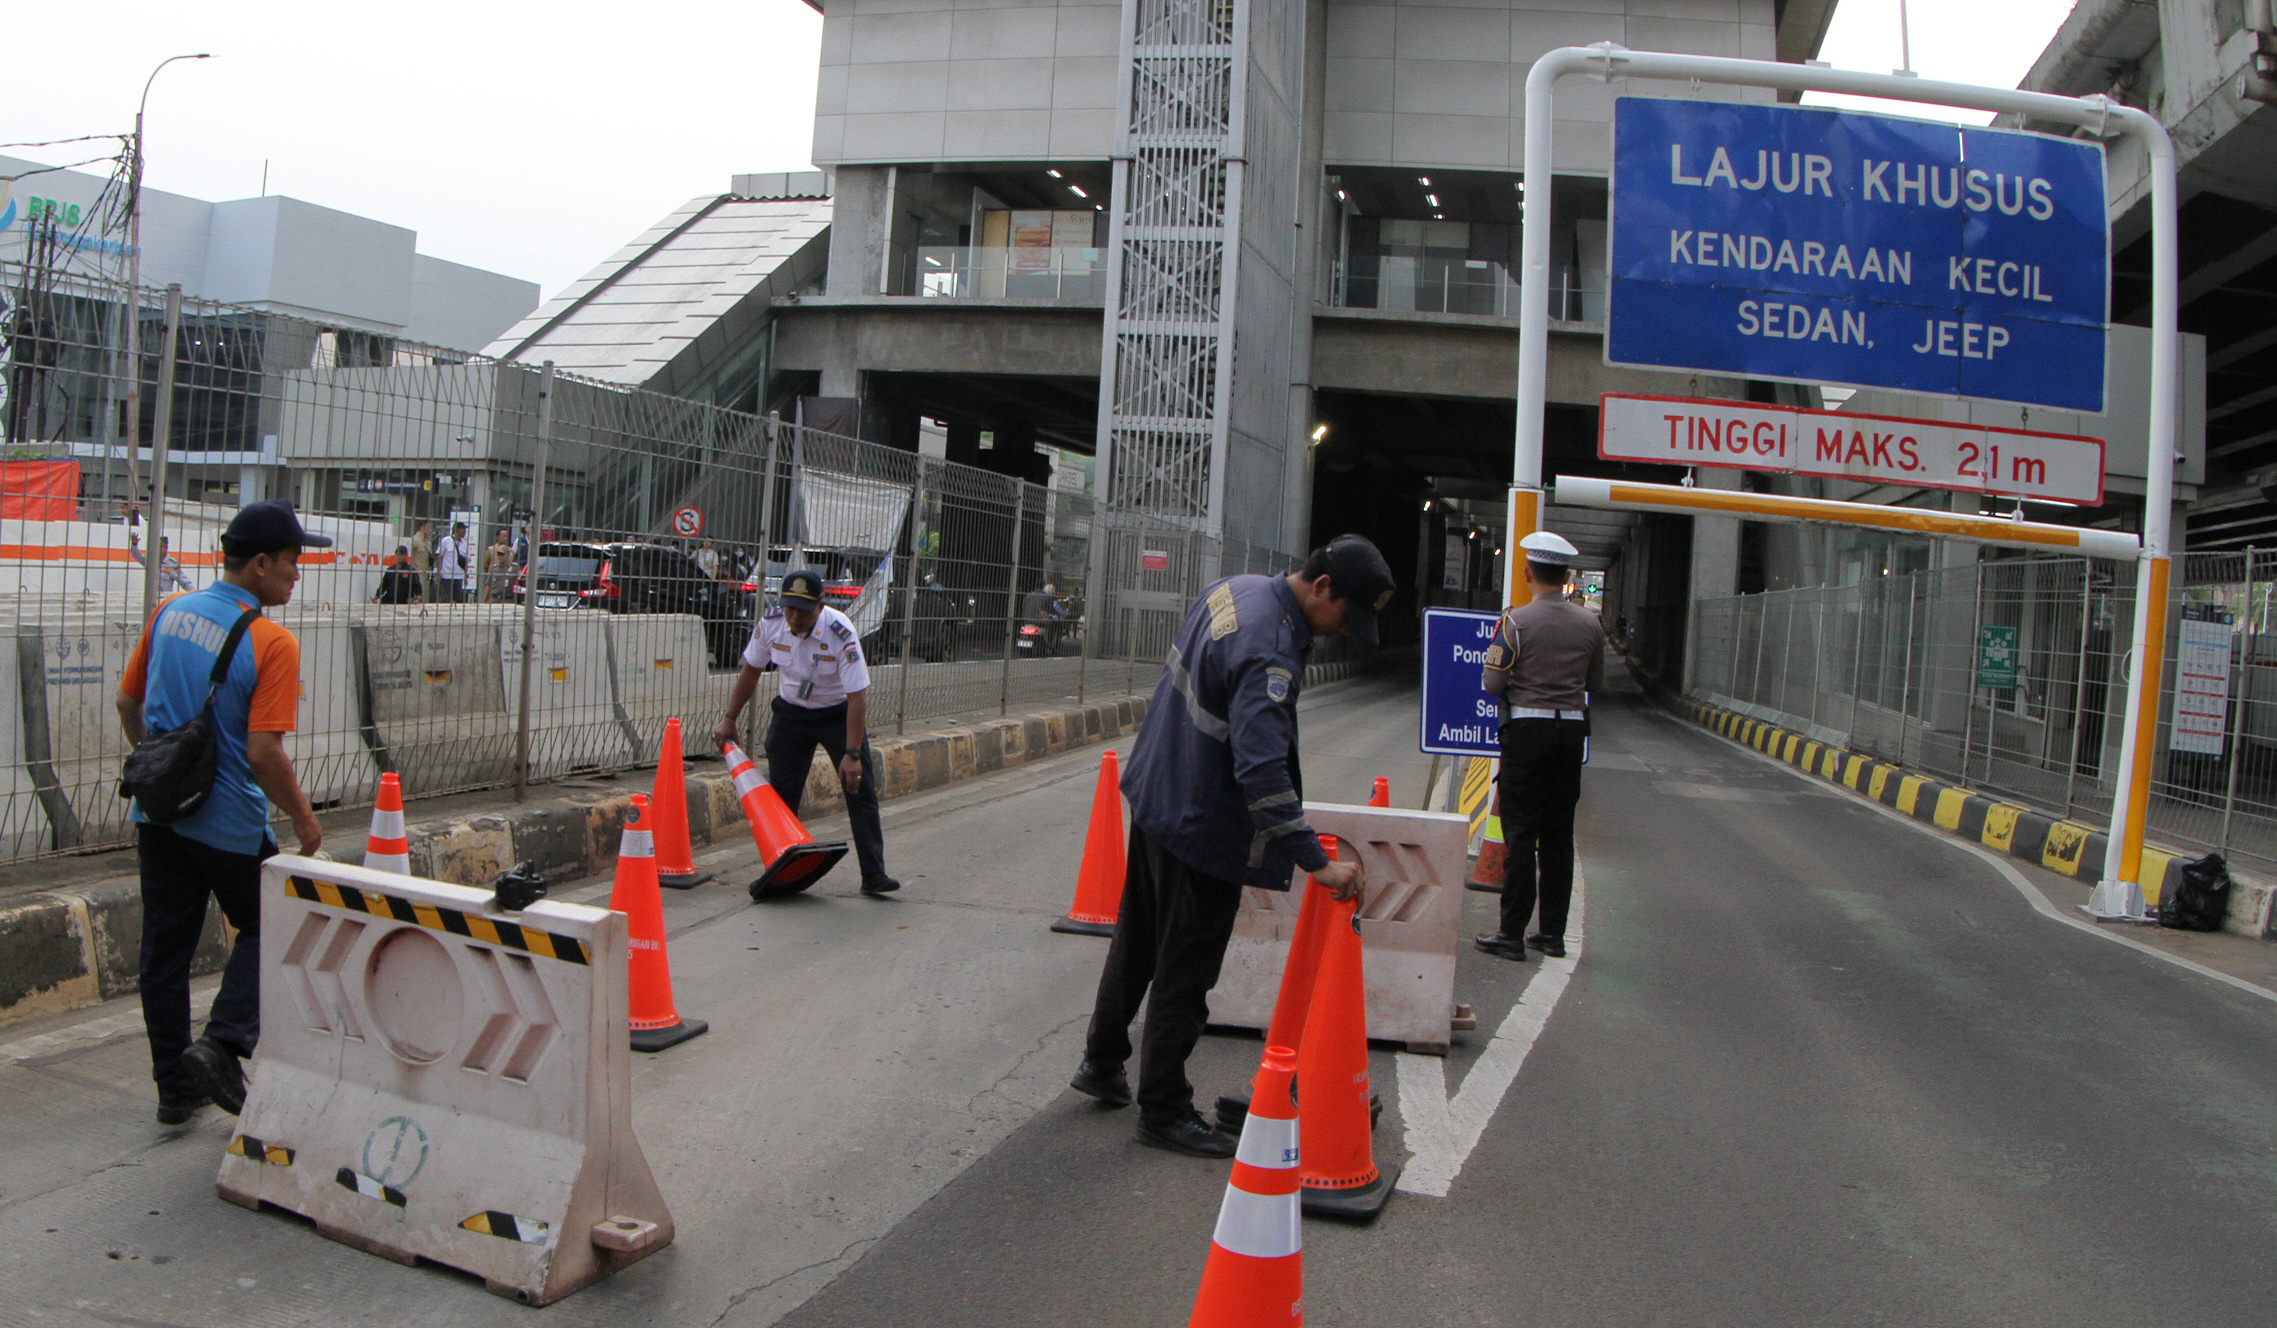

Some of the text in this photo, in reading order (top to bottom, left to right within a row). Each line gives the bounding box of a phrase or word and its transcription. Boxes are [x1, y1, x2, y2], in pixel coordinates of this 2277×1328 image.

[1671, 143, 2054, 221] LAJUR KHUSUS
[1670, 229, 2053, 302] KENDARAAN KECIL
[1737, 299, 2010, 360] SEDAN, JEEP
[1663, 414, 1787, 458] TINGGI
[1815, 427, 1928, 472] MAKS.
[160, 609, 230, 657] DISHU
[1438, 722, 1481, 744] Ambil
